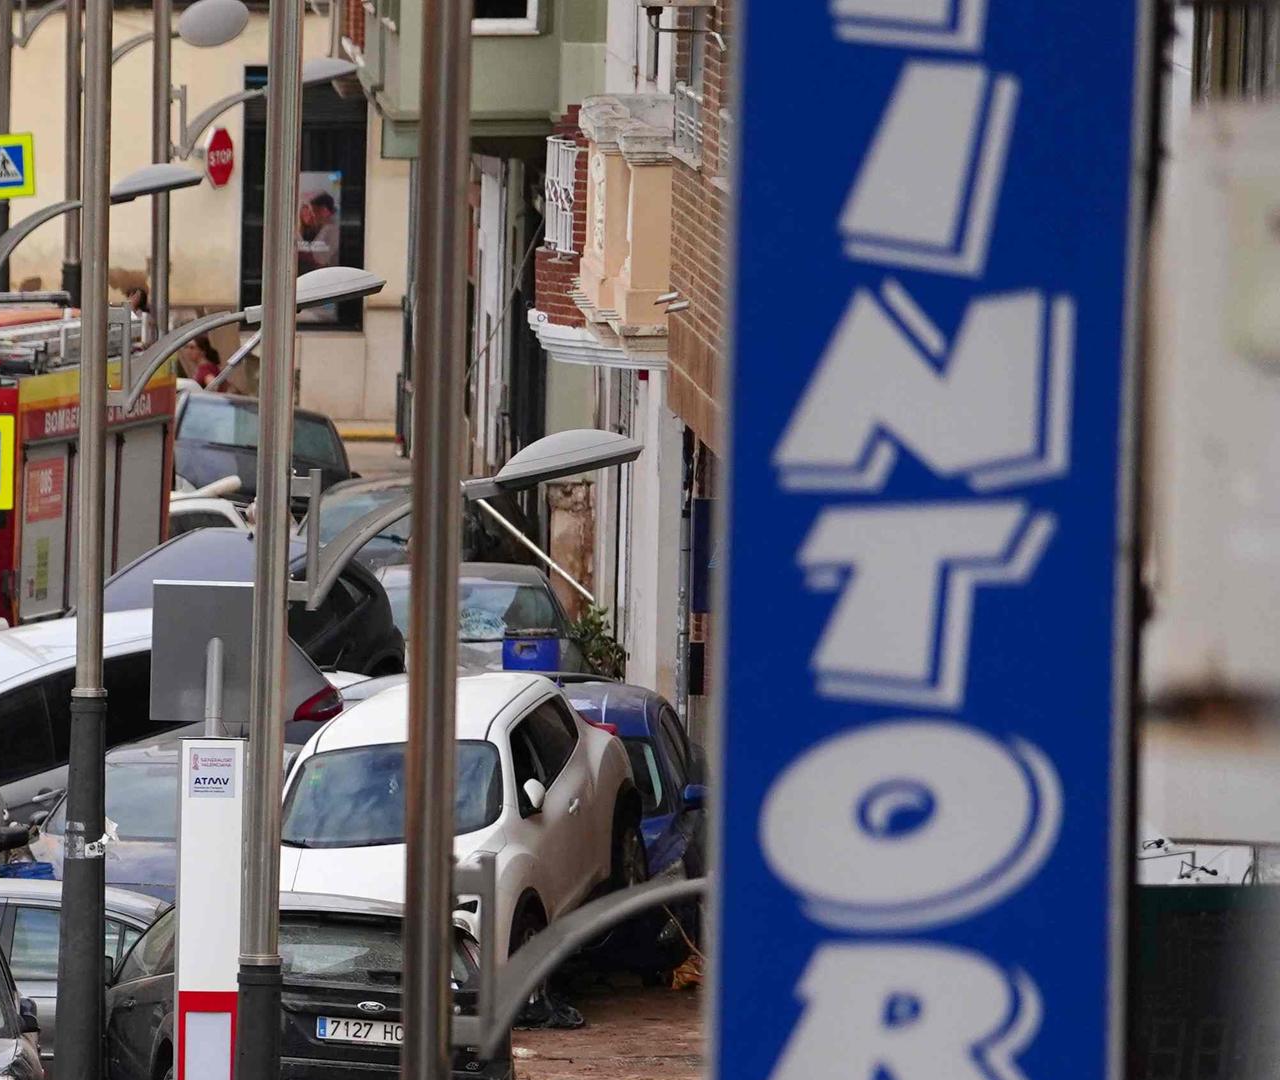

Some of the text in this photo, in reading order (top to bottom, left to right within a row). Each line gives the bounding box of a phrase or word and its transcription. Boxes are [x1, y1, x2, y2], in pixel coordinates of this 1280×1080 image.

[209, 150, 232, 166] STOP
[194, 777, 230, 785] ATMV
[330, 1020, 374, 1039] 7127
